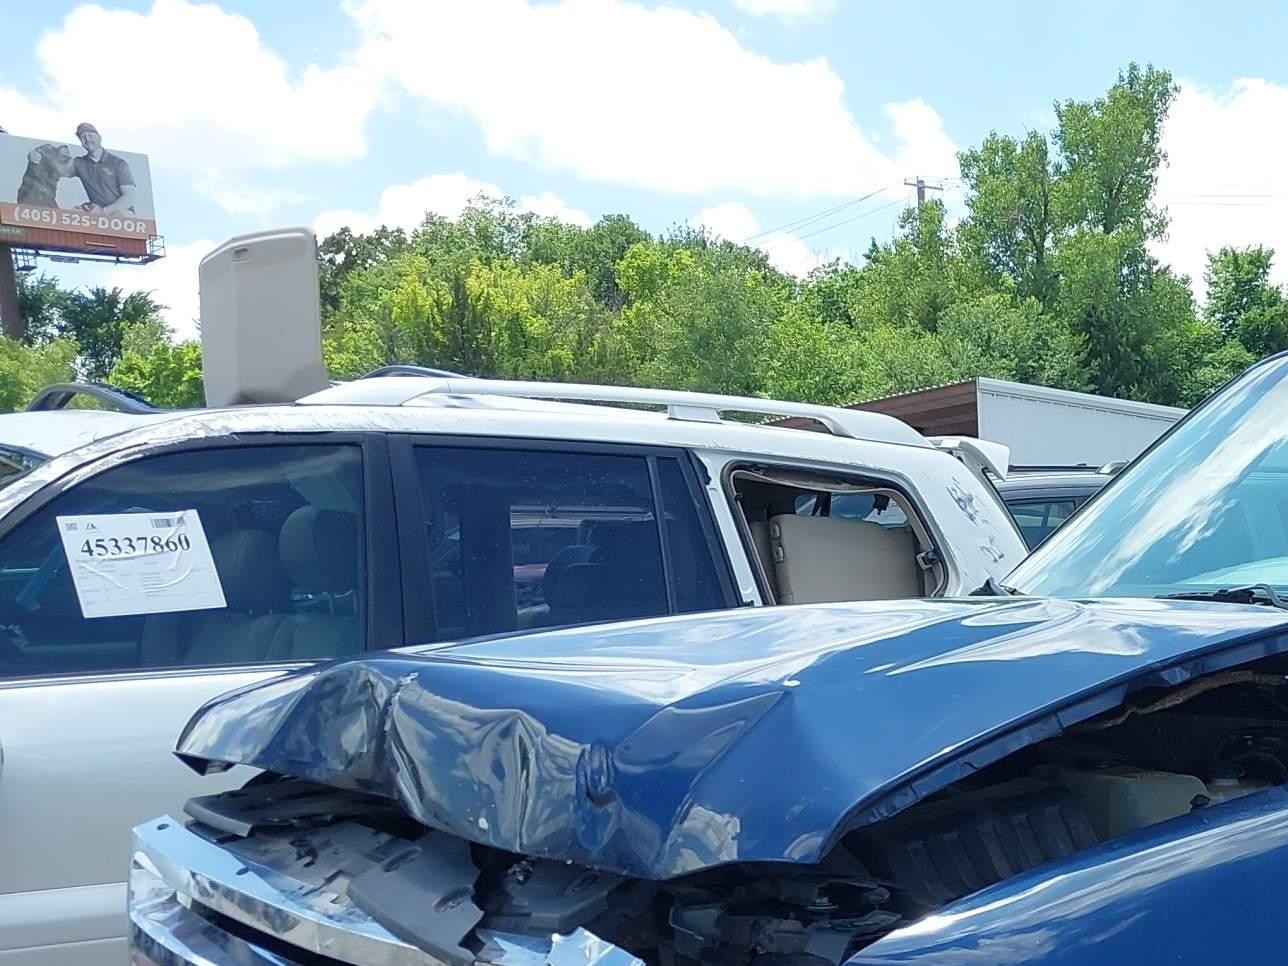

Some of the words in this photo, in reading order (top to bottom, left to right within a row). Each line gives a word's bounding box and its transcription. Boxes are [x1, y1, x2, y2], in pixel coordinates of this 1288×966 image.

[14, 207, 57, 225] (405)
[62, 213, 147, 234] 525-DOOR
[81, 533, 191, 557] 45337860
